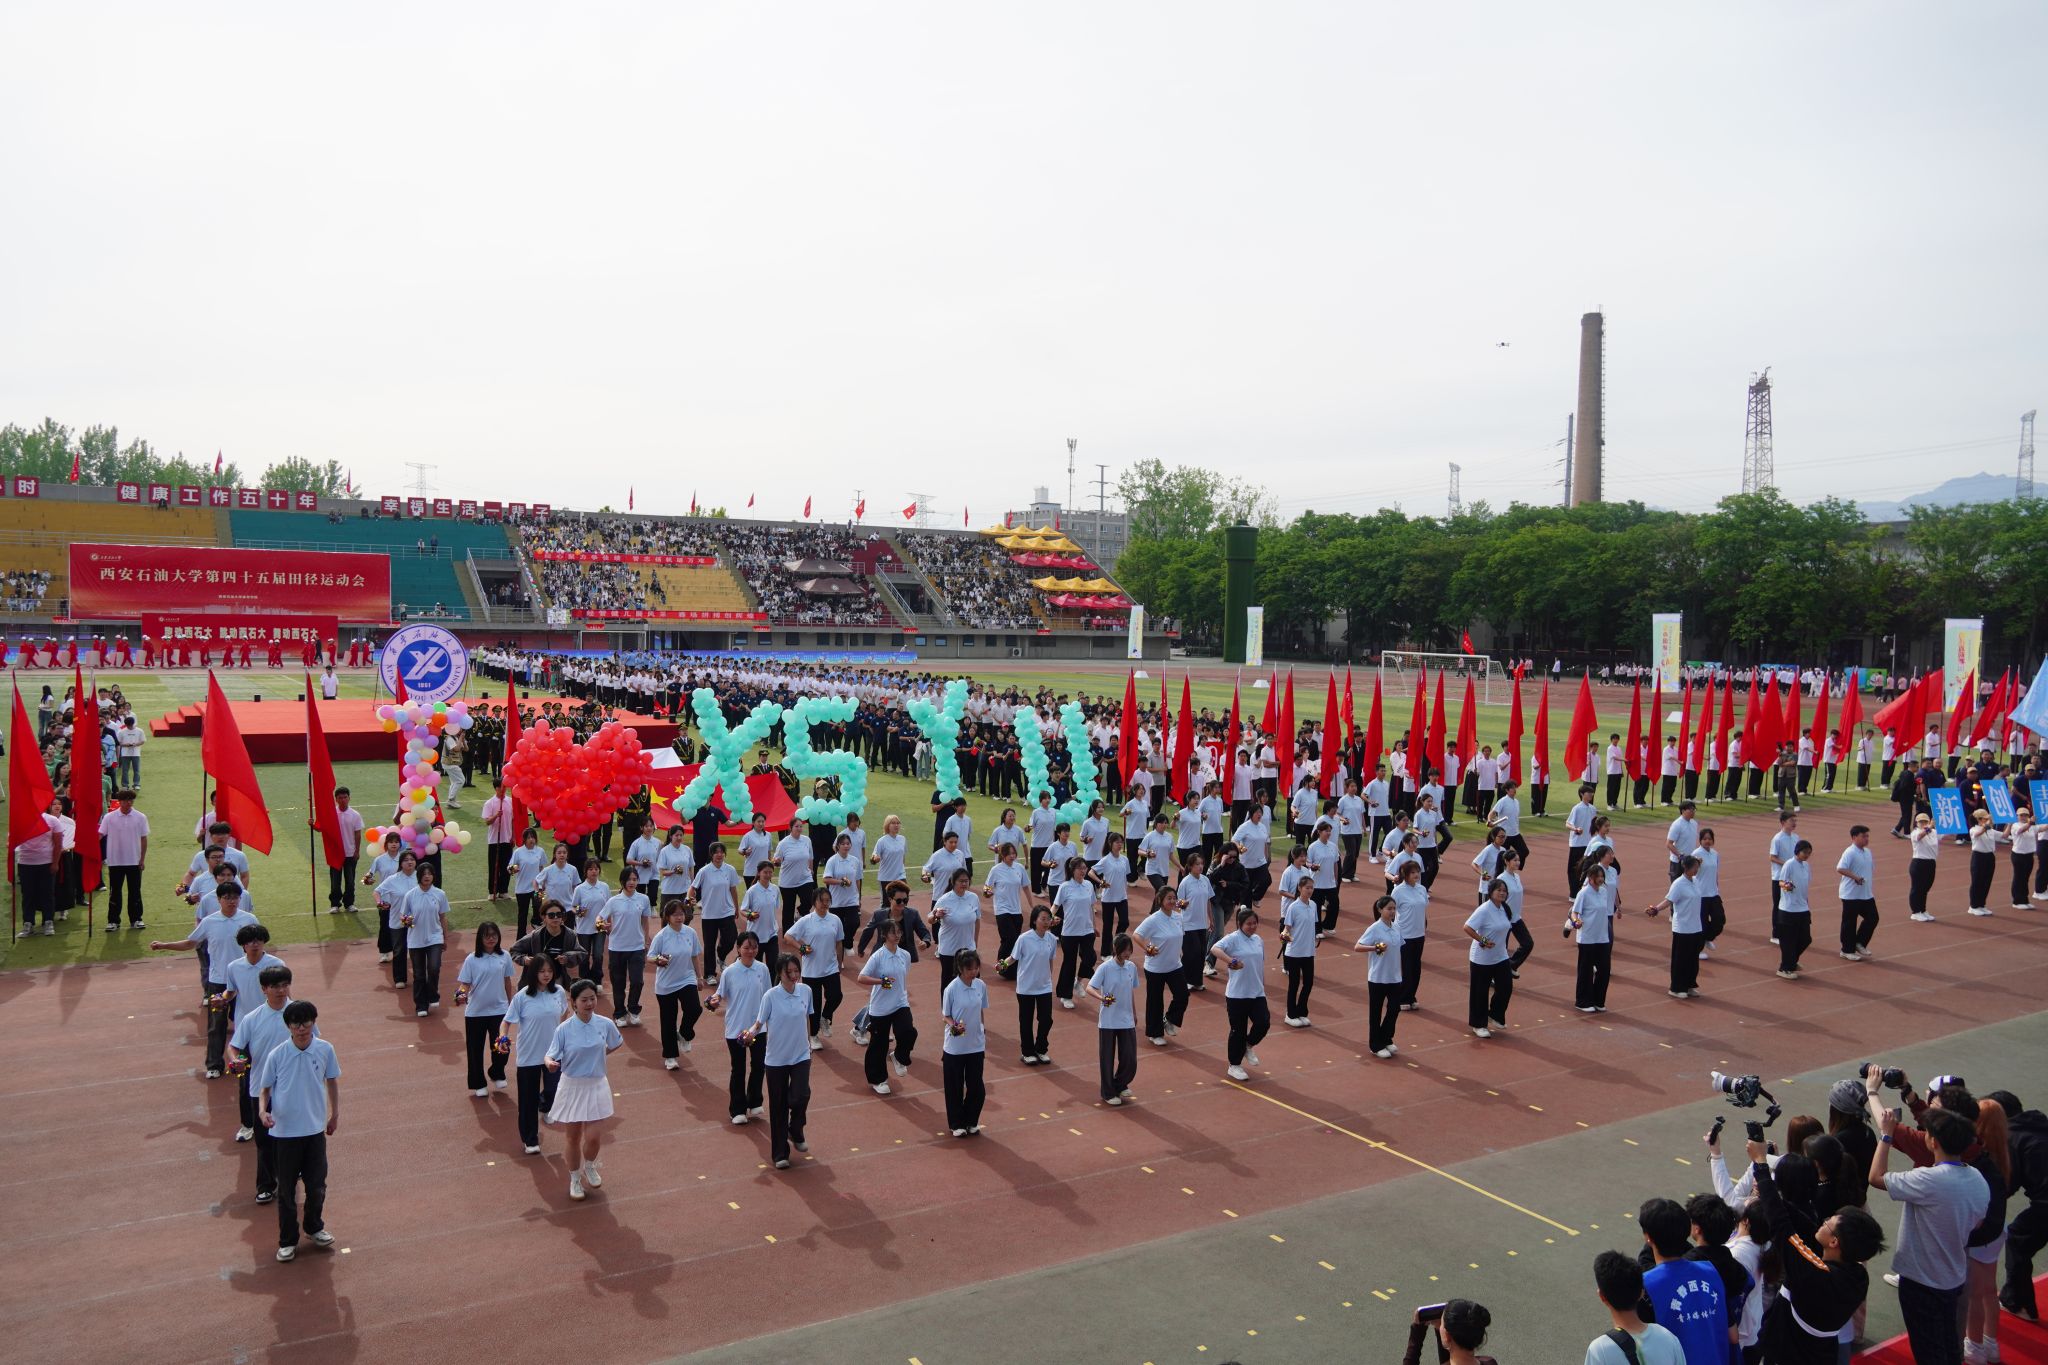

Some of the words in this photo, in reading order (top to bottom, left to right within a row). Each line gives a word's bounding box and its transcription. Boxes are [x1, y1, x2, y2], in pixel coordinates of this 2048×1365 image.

[100, 566, 366, 588] 西安石油大学第四十五届田径运动会
[1936, 793, 1962, 830] 新
[1987, 784, 2014, 818] 创
